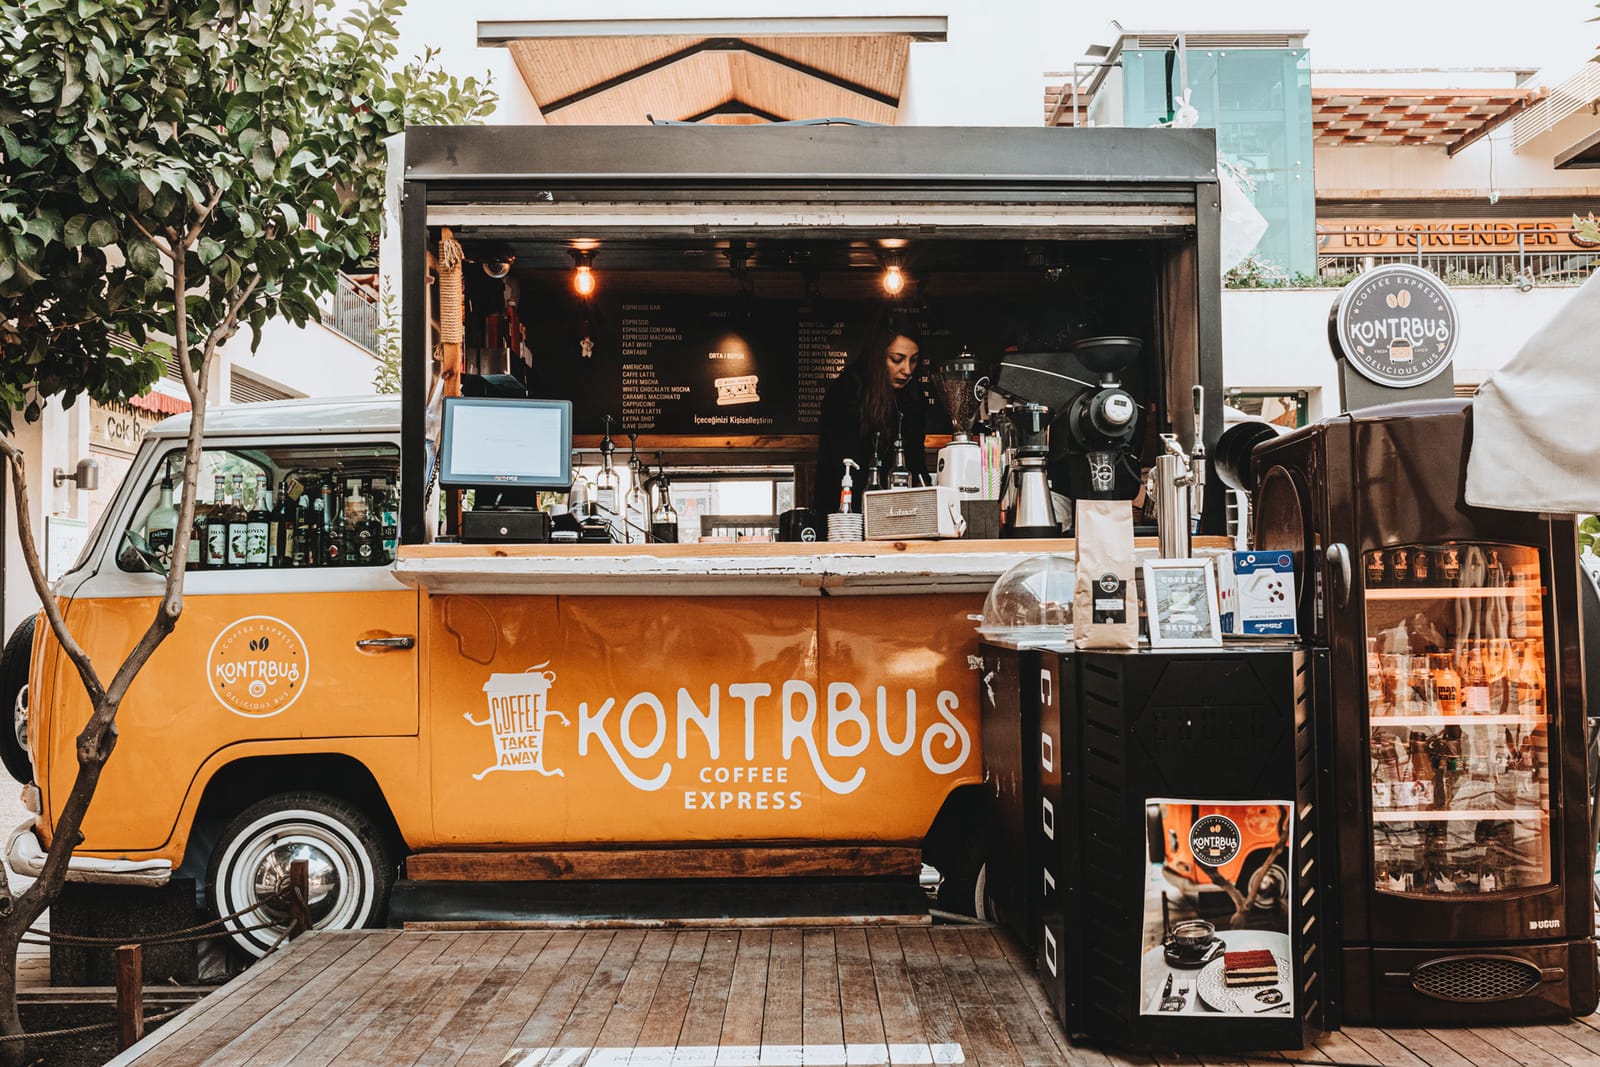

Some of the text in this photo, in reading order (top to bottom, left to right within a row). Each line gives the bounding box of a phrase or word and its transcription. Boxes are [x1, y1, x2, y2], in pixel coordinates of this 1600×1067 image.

[1344, 224, 1388, 247] HD
[1356, 277, 1440, 306] COFFEE EXPRESS
[1351, 317, 1449, 347] KONTRBUS
[1365, 353, 1439, 375] DELICIOUS BUS
[694, 413, 774, 425] İçeceğinizi Kişiselleştirin
[223, 625, 295, 649] COFFEE EXPRESS
[216, 660, 300, 685] KONTRBUS
[226, 691, 289, 709] DELICIOUS BUS
[492, 694, 541, 735] COFFEE
[500, 736, 538, 750] TAKE
[577, 679, 971, 795] KONTRBUS
[500, 751, 539, 767] AWAY
[699, 767, 789, 783] COFFEE
[684, 791, 803, 810] EXPRESS
[1193, 836, 1237, 850] KONTRBUS
